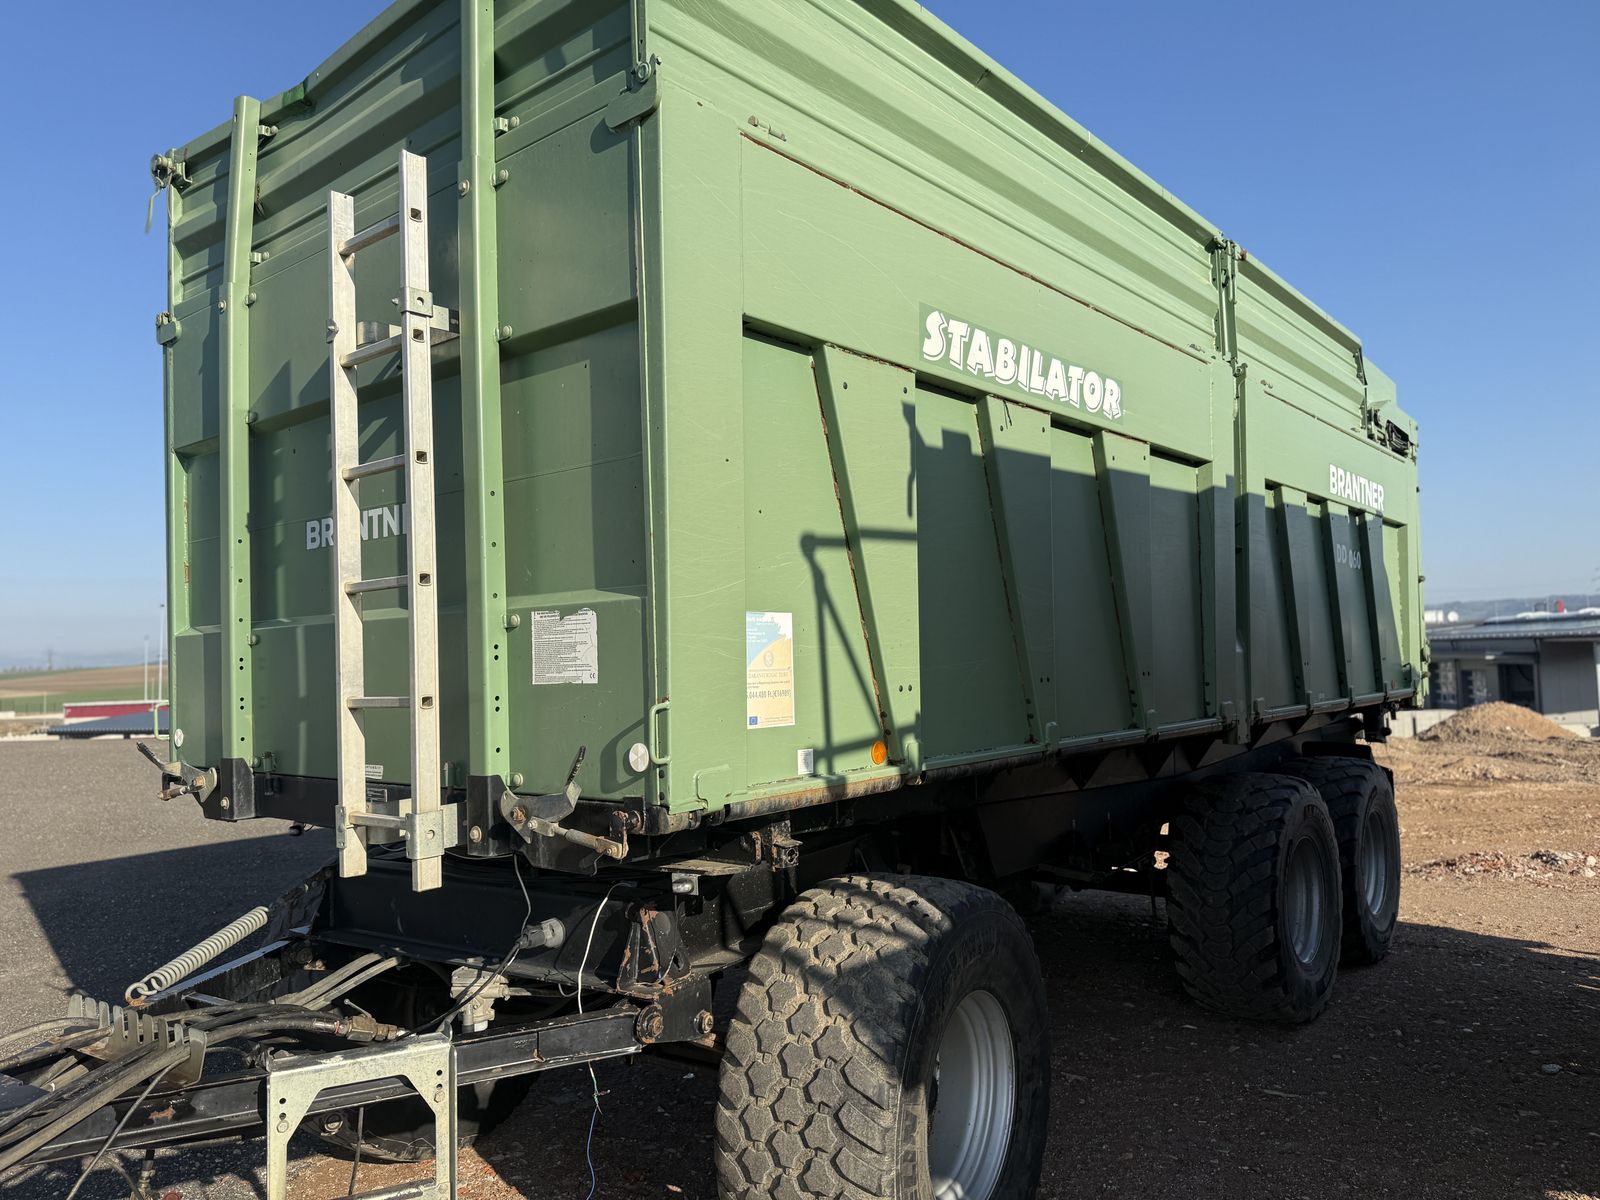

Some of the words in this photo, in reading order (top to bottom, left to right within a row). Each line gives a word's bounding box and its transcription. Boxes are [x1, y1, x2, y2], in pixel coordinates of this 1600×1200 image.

[922, 309, 1123, 421] STABILATOR
[1328, 463, 1385, 512] BRANTNER
[306, 503, 407, 551] BRNTN
